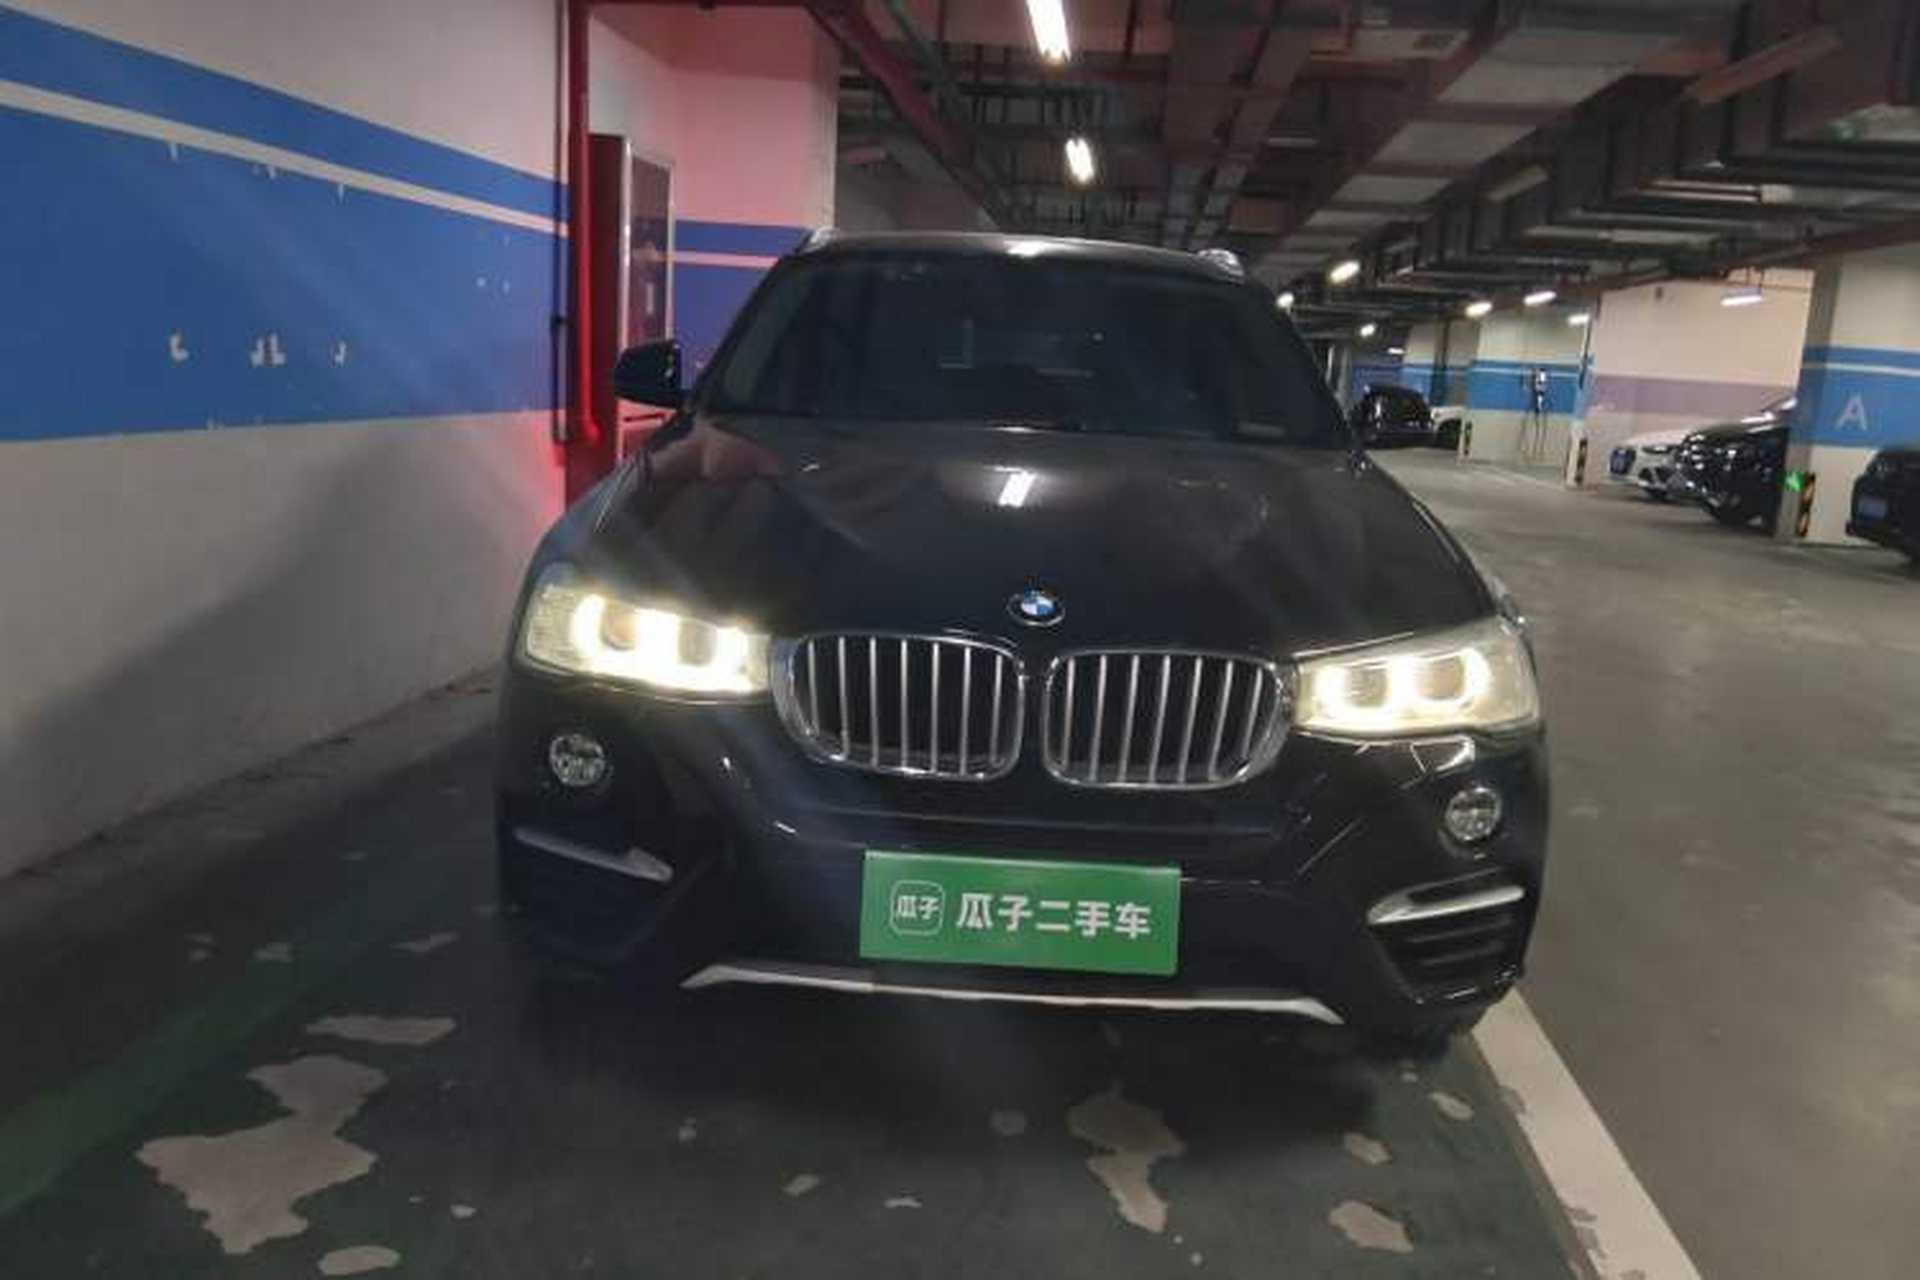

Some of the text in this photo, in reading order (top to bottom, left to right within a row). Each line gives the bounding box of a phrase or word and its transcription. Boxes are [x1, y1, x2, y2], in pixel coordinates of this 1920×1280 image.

[1835, 393, 1868, 430] A
[896, 892, 1151, 939] 瓜子 瓜子二手车
